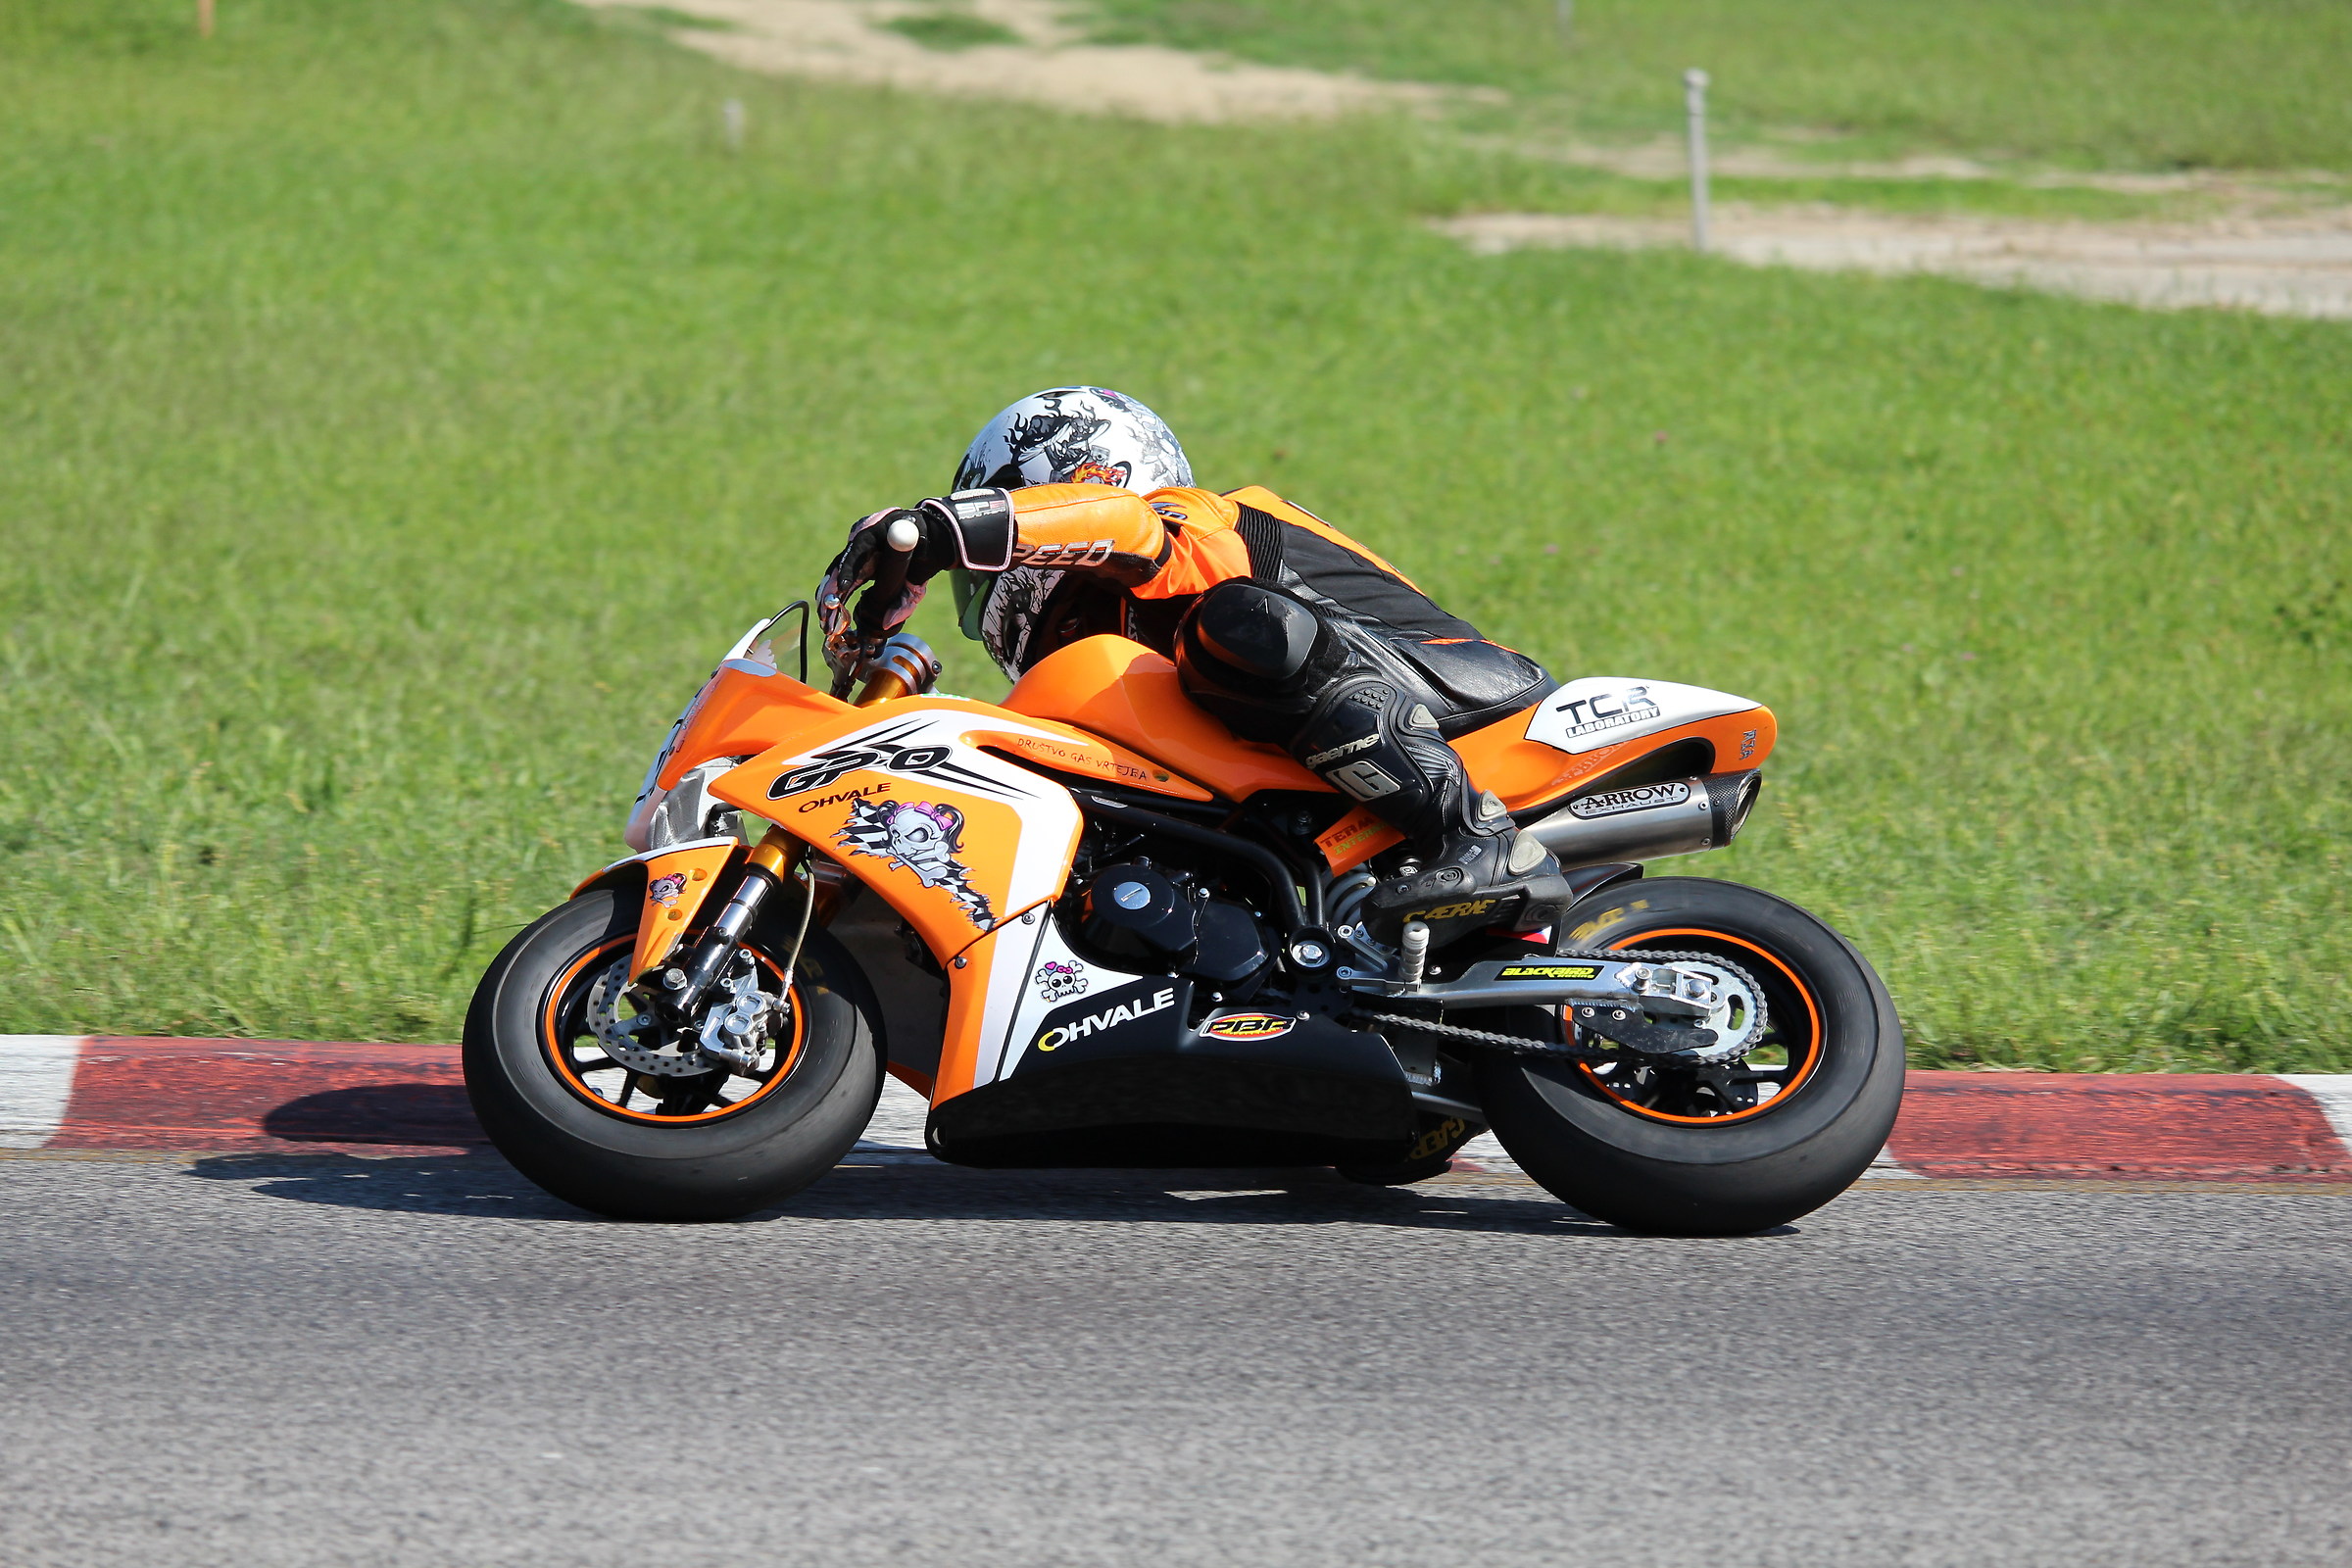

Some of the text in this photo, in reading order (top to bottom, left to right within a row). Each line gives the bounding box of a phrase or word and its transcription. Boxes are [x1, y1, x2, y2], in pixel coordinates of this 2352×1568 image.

[1012, 539, 1116, 567] PEED
[1555, 685, 1657, 725] TCR
[1565, 706, 1661, 739] LABORATORY
[1071, 752, 1092, 765] GAS
[798, 782, 892, 813] OHVALE
[1581, 783, 1676, 810] ARROW
[1585, 796, 1679, 814] EXHAUST
[1500, 966, 1594, 979] BLACKBIRD
[1037, 987, 1175, 1053] OHVALE
